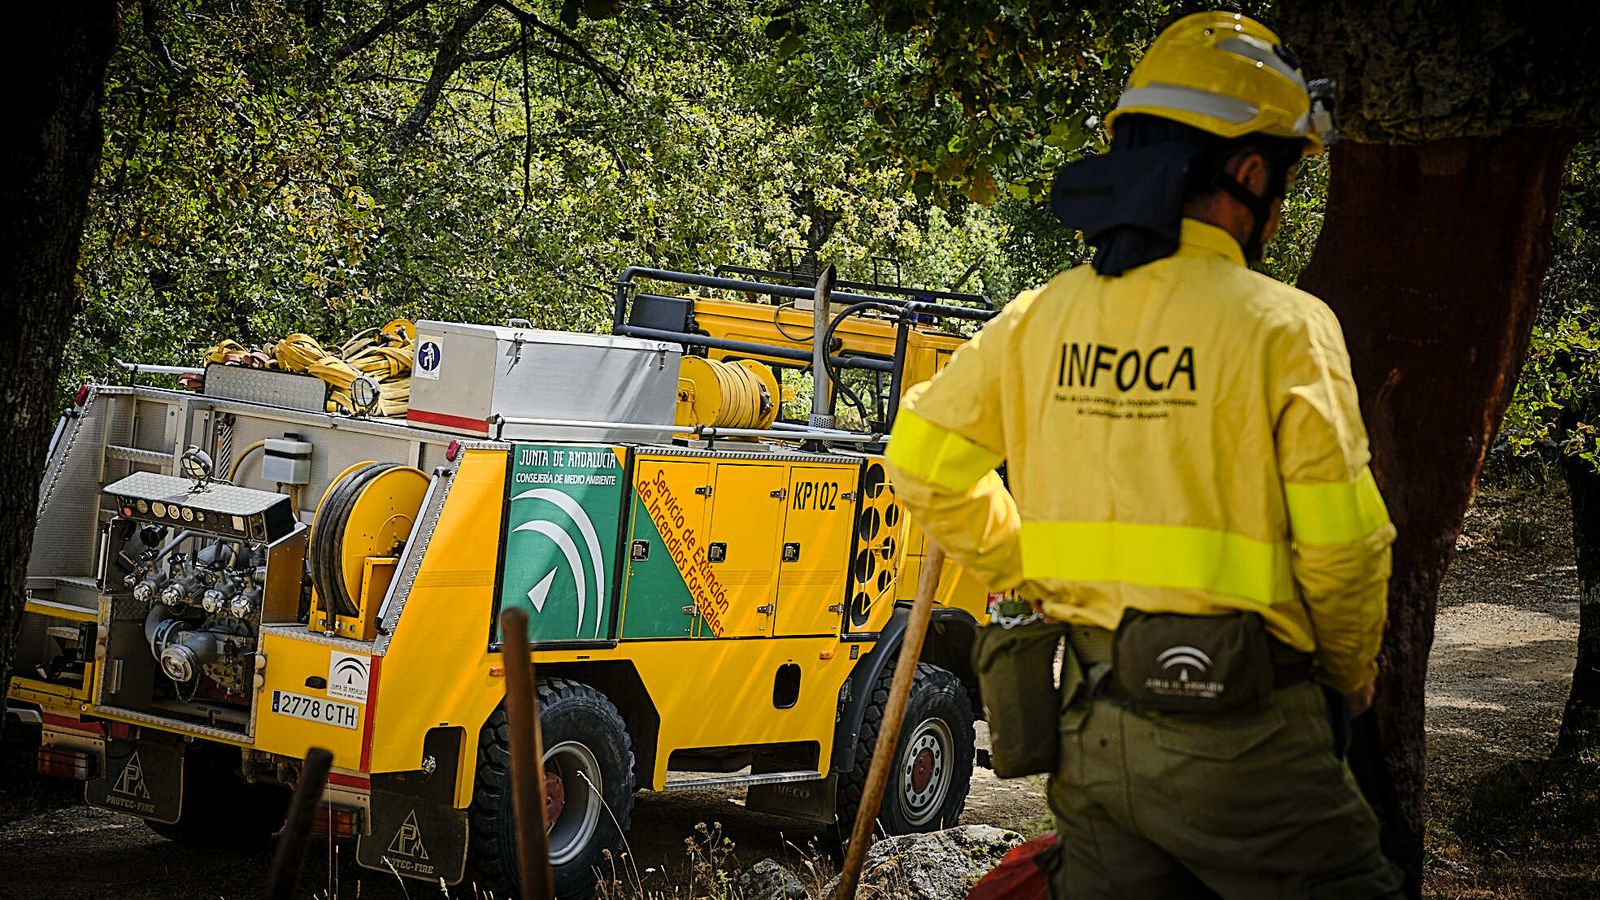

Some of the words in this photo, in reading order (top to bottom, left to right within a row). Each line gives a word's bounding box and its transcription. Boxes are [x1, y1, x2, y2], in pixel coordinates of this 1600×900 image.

[1058, 343, 1196, 392] INFOCA
[519, 449, 549, 466] JUNTA
[553, 451, 565, 467] DE
[568, 452, 616, 469] ANDALUCIA
[516, 471, 553, 484] CONSEJERÍA
[554, 474, 564, 484] DE
[564, 474, 585, 485] MEDIO
[585, 475, 616, 486] AMBIENTE
[793, 481, 838, 510] KP102
[653, 469, 685, 529] Servicio
[682, 529, 696, 551] de
[692, 546, 729, 615] Extinción
[637, 480, 652, 503] de
[648, 497, 688, 571] Incendios
[684, 565, 724, 638] Forestales
[281, 695, 320, 718] 2778
[325, 703, 355, 726] CTH
